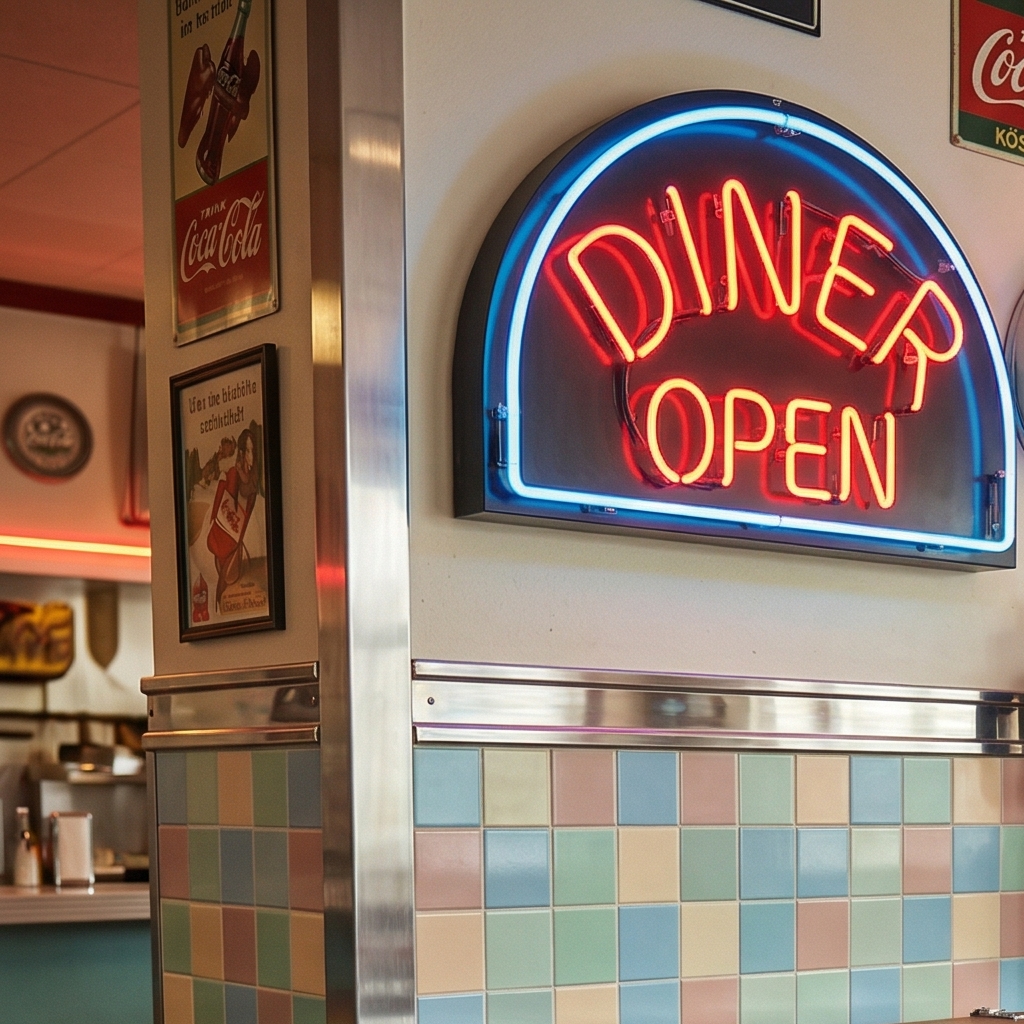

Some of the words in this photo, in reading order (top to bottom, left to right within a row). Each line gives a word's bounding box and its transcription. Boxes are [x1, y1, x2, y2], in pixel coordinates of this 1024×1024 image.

[180, 190, 265, 283] Coca-Cola
[567, 179, 964, 412] DINER
[647, 378, 896, 509] OPEN
